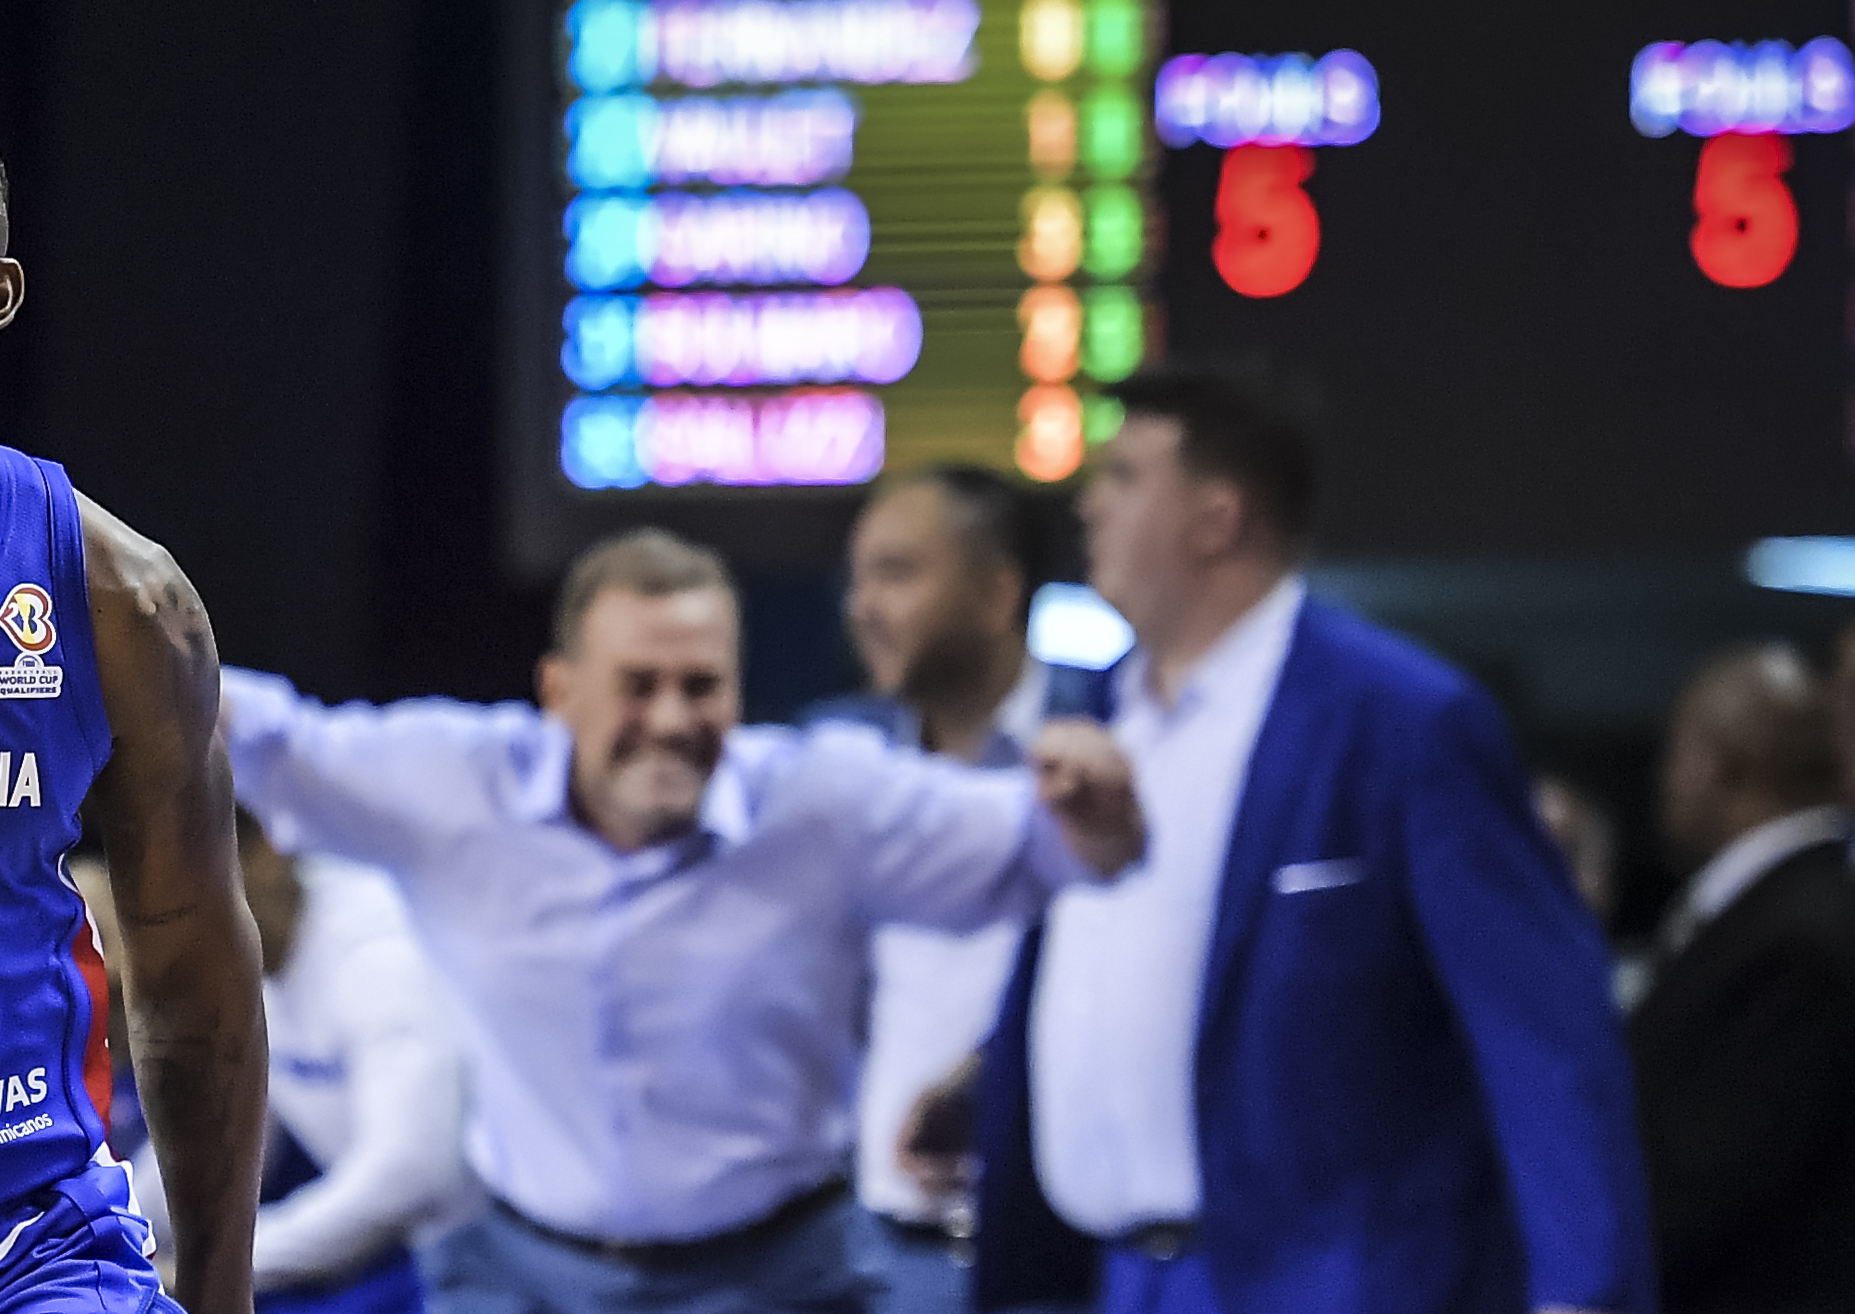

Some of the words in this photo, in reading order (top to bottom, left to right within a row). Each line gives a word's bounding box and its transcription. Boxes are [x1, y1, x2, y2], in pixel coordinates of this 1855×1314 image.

[0, 676, 36, 685] WORLD
[39, 675, 59, 685] CUP
[0, 687, 57, 695] QUALIFIERS
